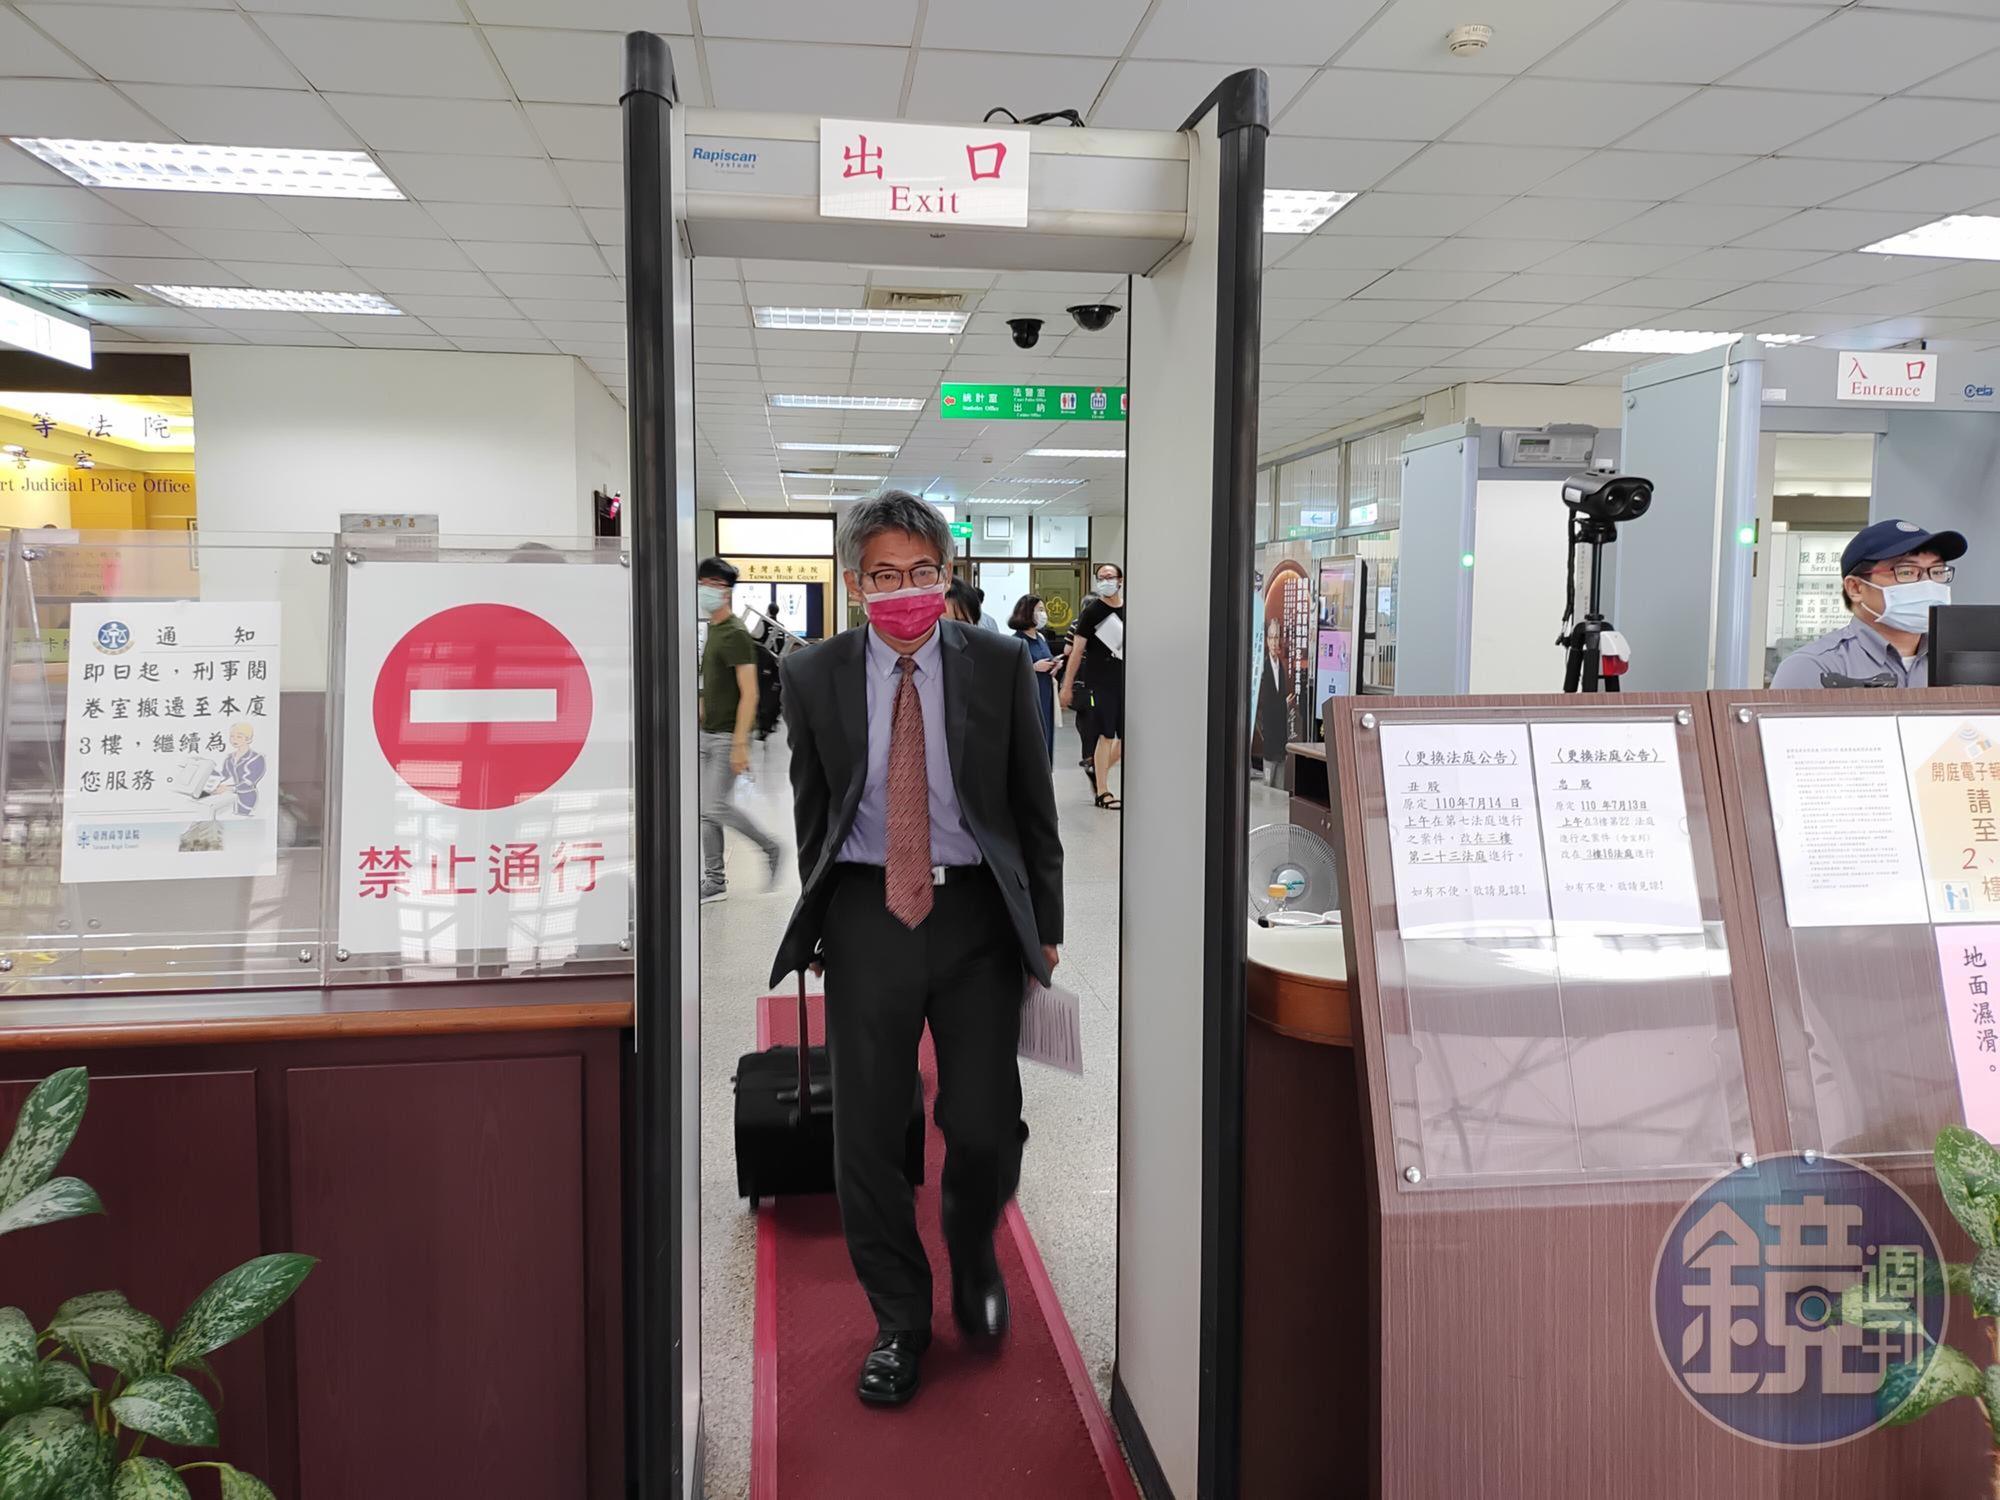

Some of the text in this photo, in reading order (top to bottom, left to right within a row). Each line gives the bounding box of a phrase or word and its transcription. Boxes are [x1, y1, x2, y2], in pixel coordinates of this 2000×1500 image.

[692, 147, 757, 163] Rapiscan
[842, 134, 1008, 182] 出口
[889, 184, 961, 215] Exit
[1848, 356, 1926, 380] 入口
[1851, 381, 1921, 397] Entrance
[21, 477, 83, 492] Judicial
[91, 477, 137, 492] Police
[143, 478, 191, 493] Office
[155, 625, 256, 647] 通知
[79, 769, 174, 793] 您服務。
[357, 841, 606, 900] 禁止通行
